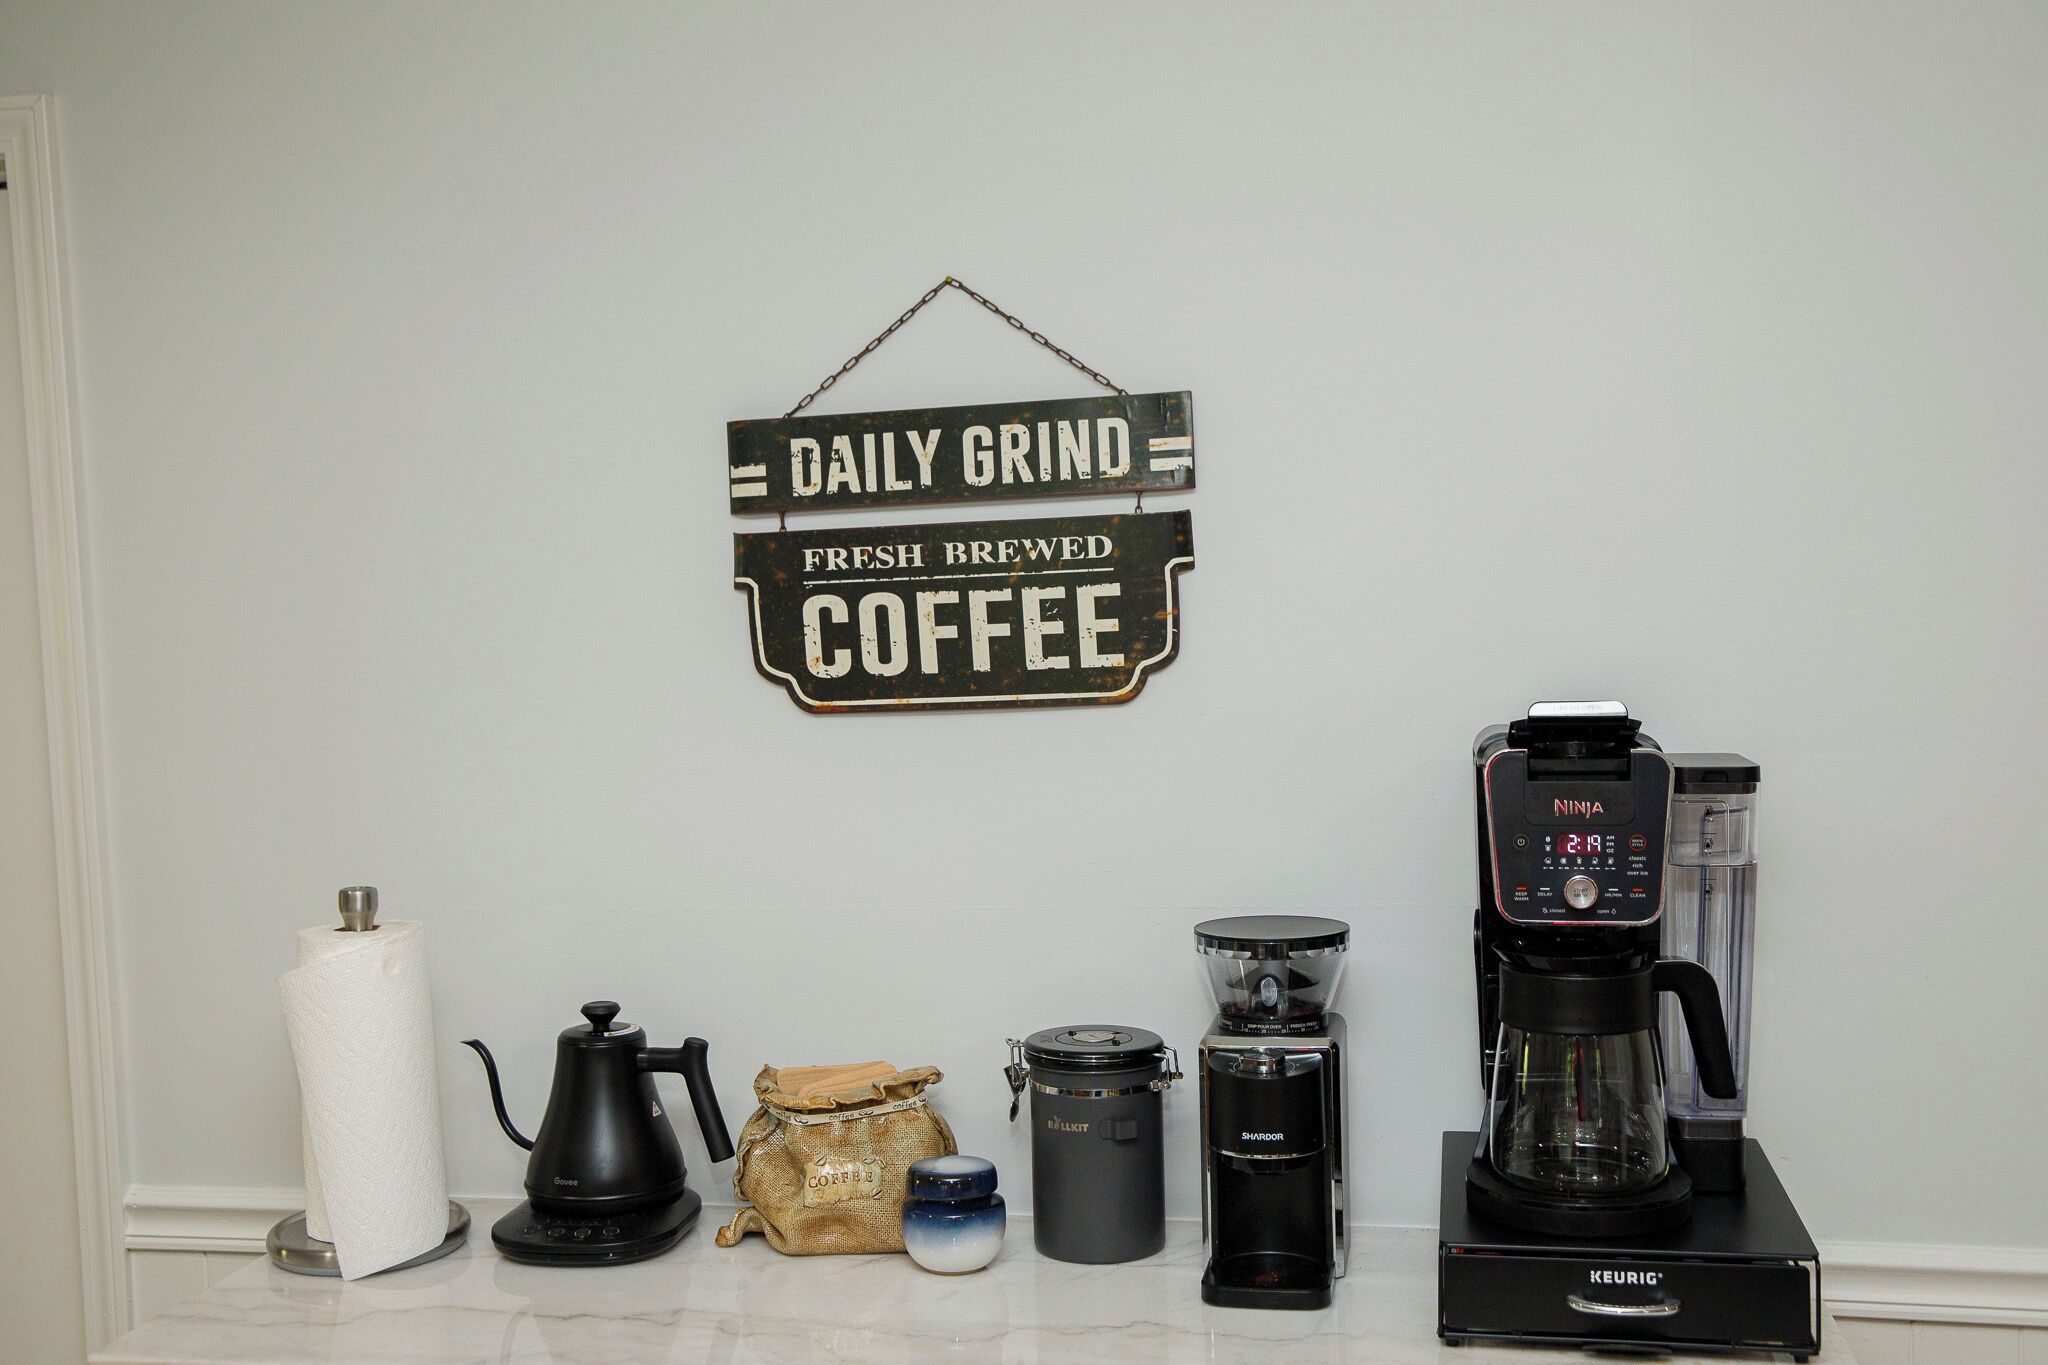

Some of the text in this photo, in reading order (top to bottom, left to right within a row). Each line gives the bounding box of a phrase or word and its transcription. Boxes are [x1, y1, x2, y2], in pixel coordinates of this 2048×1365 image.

[790, 416, 1132, 497] DAILY GRIND
[802, 534, 1114, 573] FRESH BREWED
[802, 582, 1126, 679] COFFEE
[1554, 799, 1604, 819] NINJA
[1567, 834, 1601, 853] 2:19
[892, 1100, 917, 1110] coffee
[828, 1110, 855, 1121] coffee
[1242, 1132, 1284, 1141] SHARDOR
[553, 1177, 578, 1186] Govee
[808, 1171, 874, 1189] COFFEE
